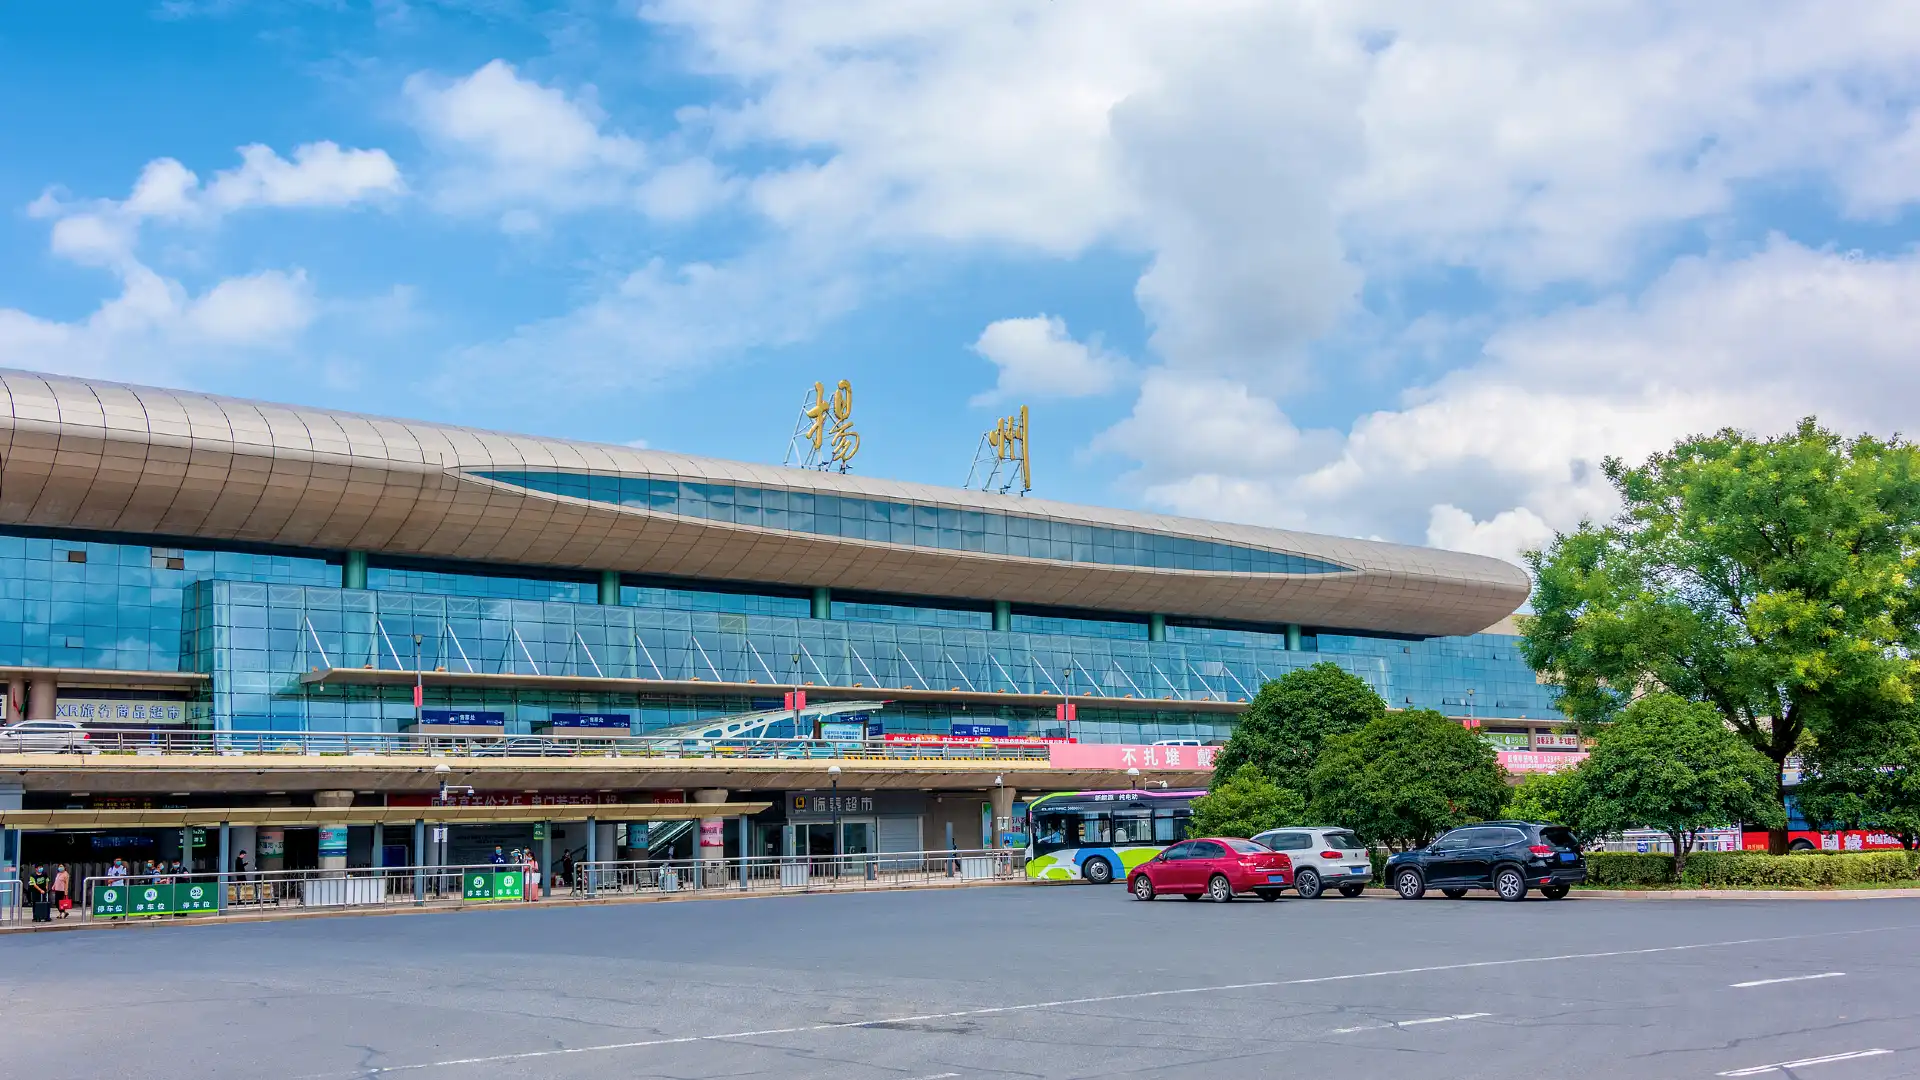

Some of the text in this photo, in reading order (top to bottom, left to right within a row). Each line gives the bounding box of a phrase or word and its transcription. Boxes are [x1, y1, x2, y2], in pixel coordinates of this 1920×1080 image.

[56, 703, 181, 719] XR旅行商品超市
[1121, 747, 1181, 767] 不扎堆
[107, 893, 114, 901] 9
[191, 889, 202, 897] 22
[467, 889, 490, 897] 停车位
[97, 904, 123, 912] 停车位
[136, 902, 165, 910] 停车位
[182, 901, 210, 909] 停车位
